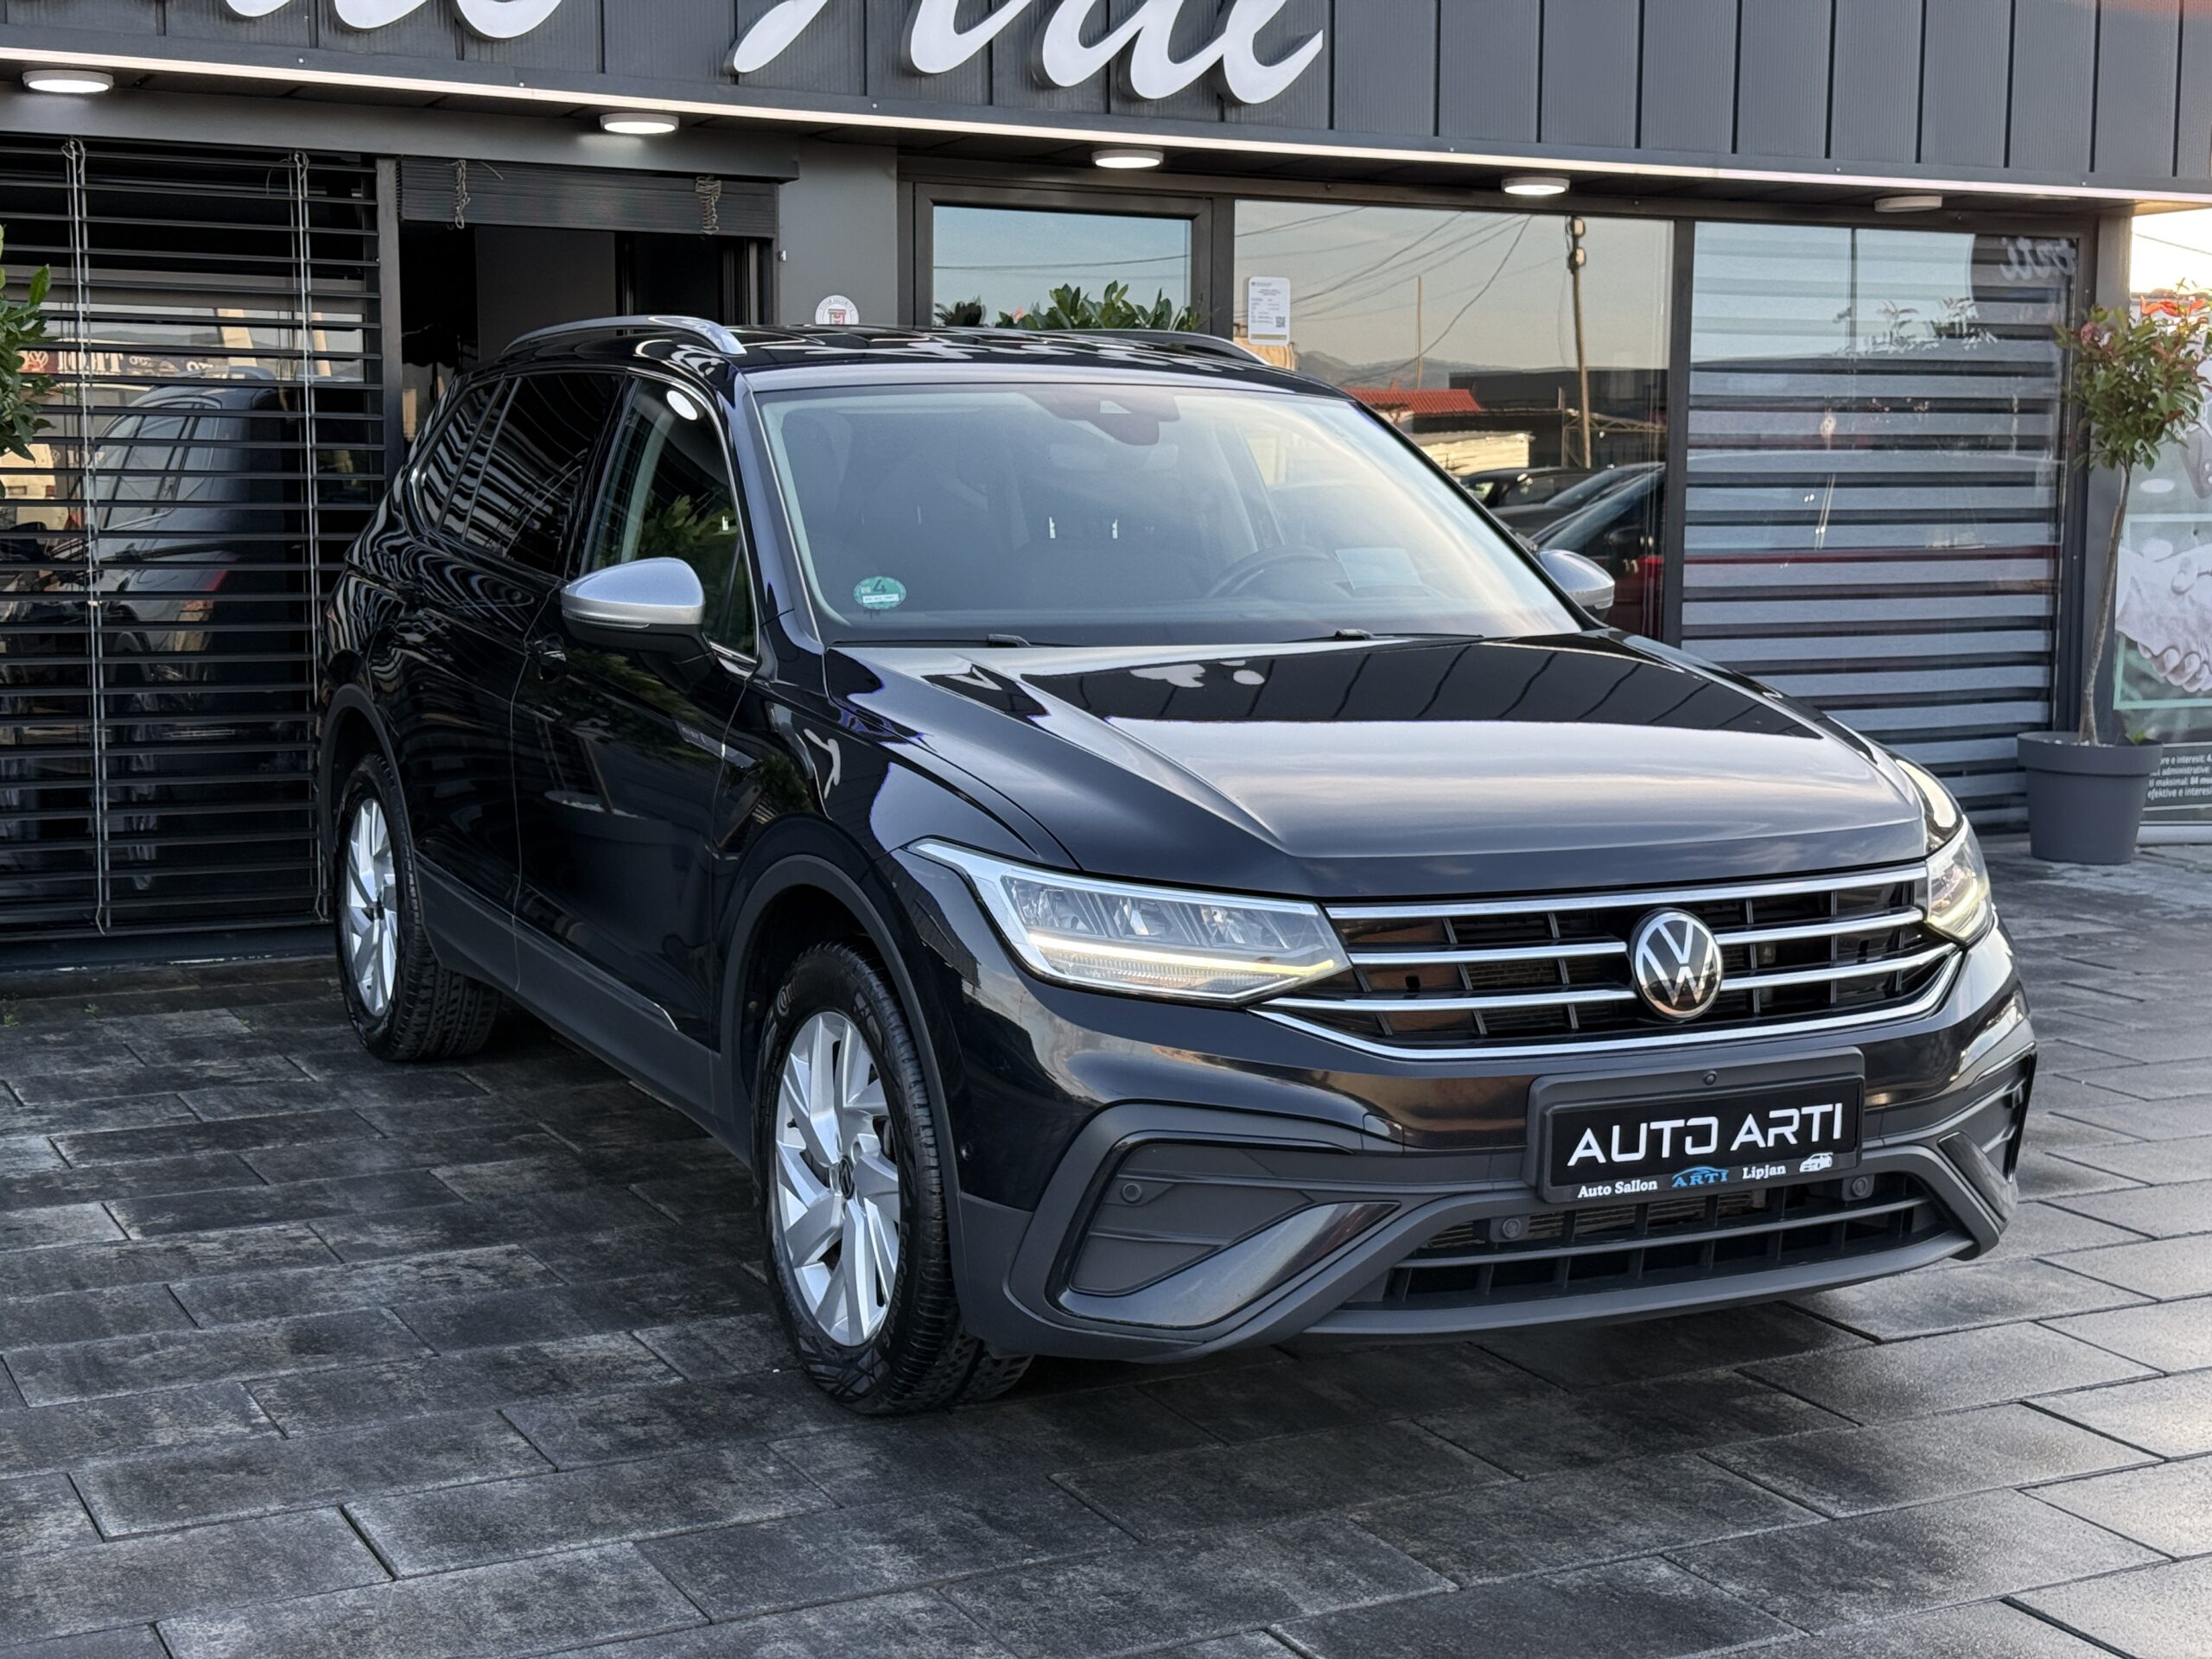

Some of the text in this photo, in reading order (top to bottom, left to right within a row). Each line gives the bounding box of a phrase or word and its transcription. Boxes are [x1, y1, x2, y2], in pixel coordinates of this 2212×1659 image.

[873, 579, 887, 594] 4
[1567, 1103, 1842, 1166] AUTO ARTI
[1577, 1184, 1611, 1198] Auto
[1672, 1170, 1728, 1188] ARTI
[1742, 1164, 1786, 1181] Lipjan
